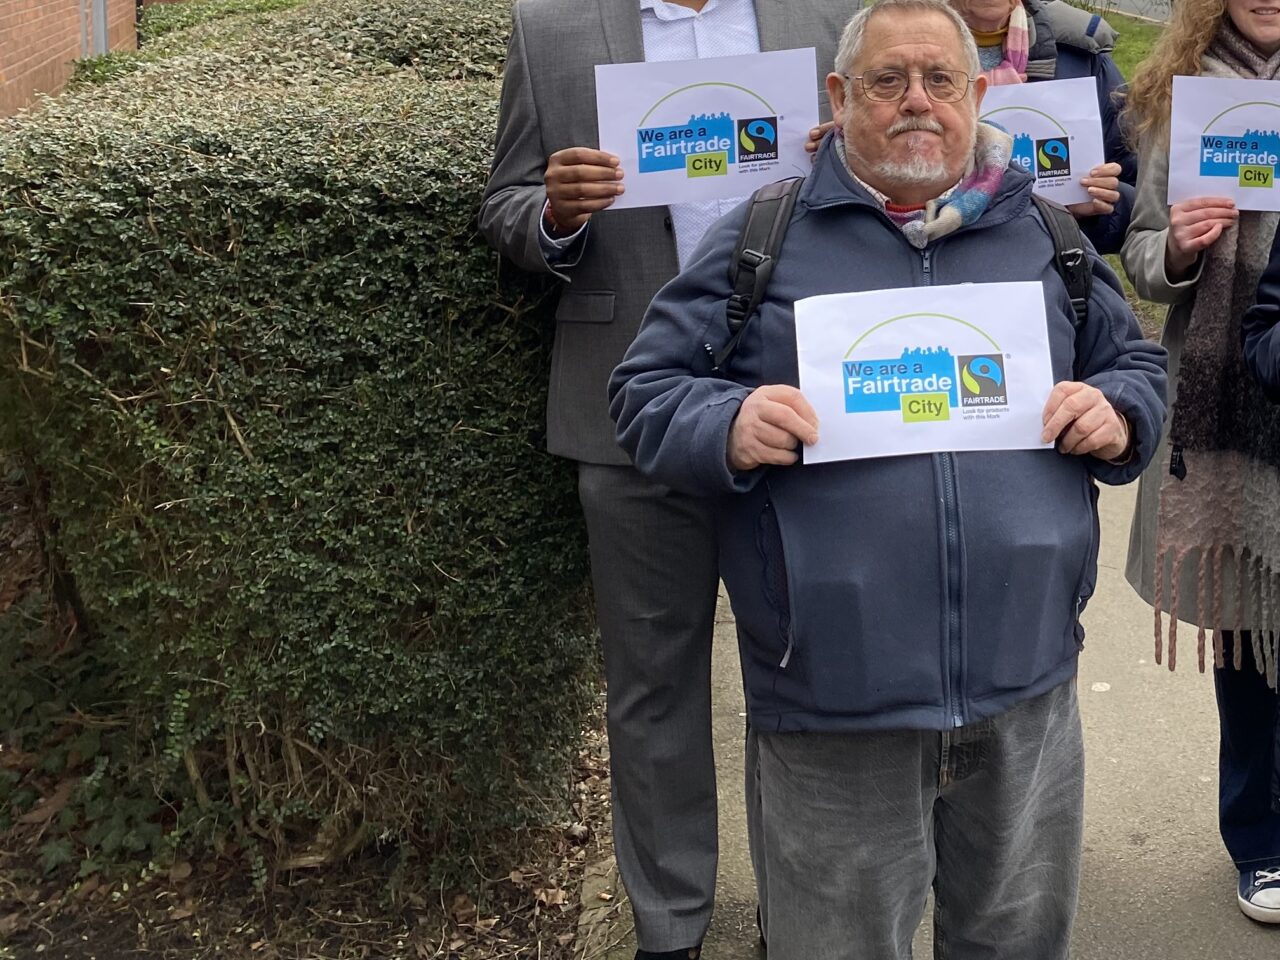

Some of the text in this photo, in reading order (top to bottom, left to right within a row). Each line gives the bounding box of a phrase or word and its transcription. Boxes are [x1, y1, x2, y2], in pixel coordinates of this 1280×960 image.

[639, 128, 706, 142] We are a
[641, 136, 731, 159] Fairtrade
[1203, 138, 1258, 150] We are a
[740, 152, 776, 160] FAIRTRADE
[1203, 148, 1278, 165] Fairtrade
[692, 157, 722, 173] City
[1244, 170, 1269, 184] City
[845, 363, 923, 376] We are a
[848, 374, 952, 395] Fairtrade
[908, 399, 943, 416] City
[964, 396, 1005, 405] FAIRTRADE
